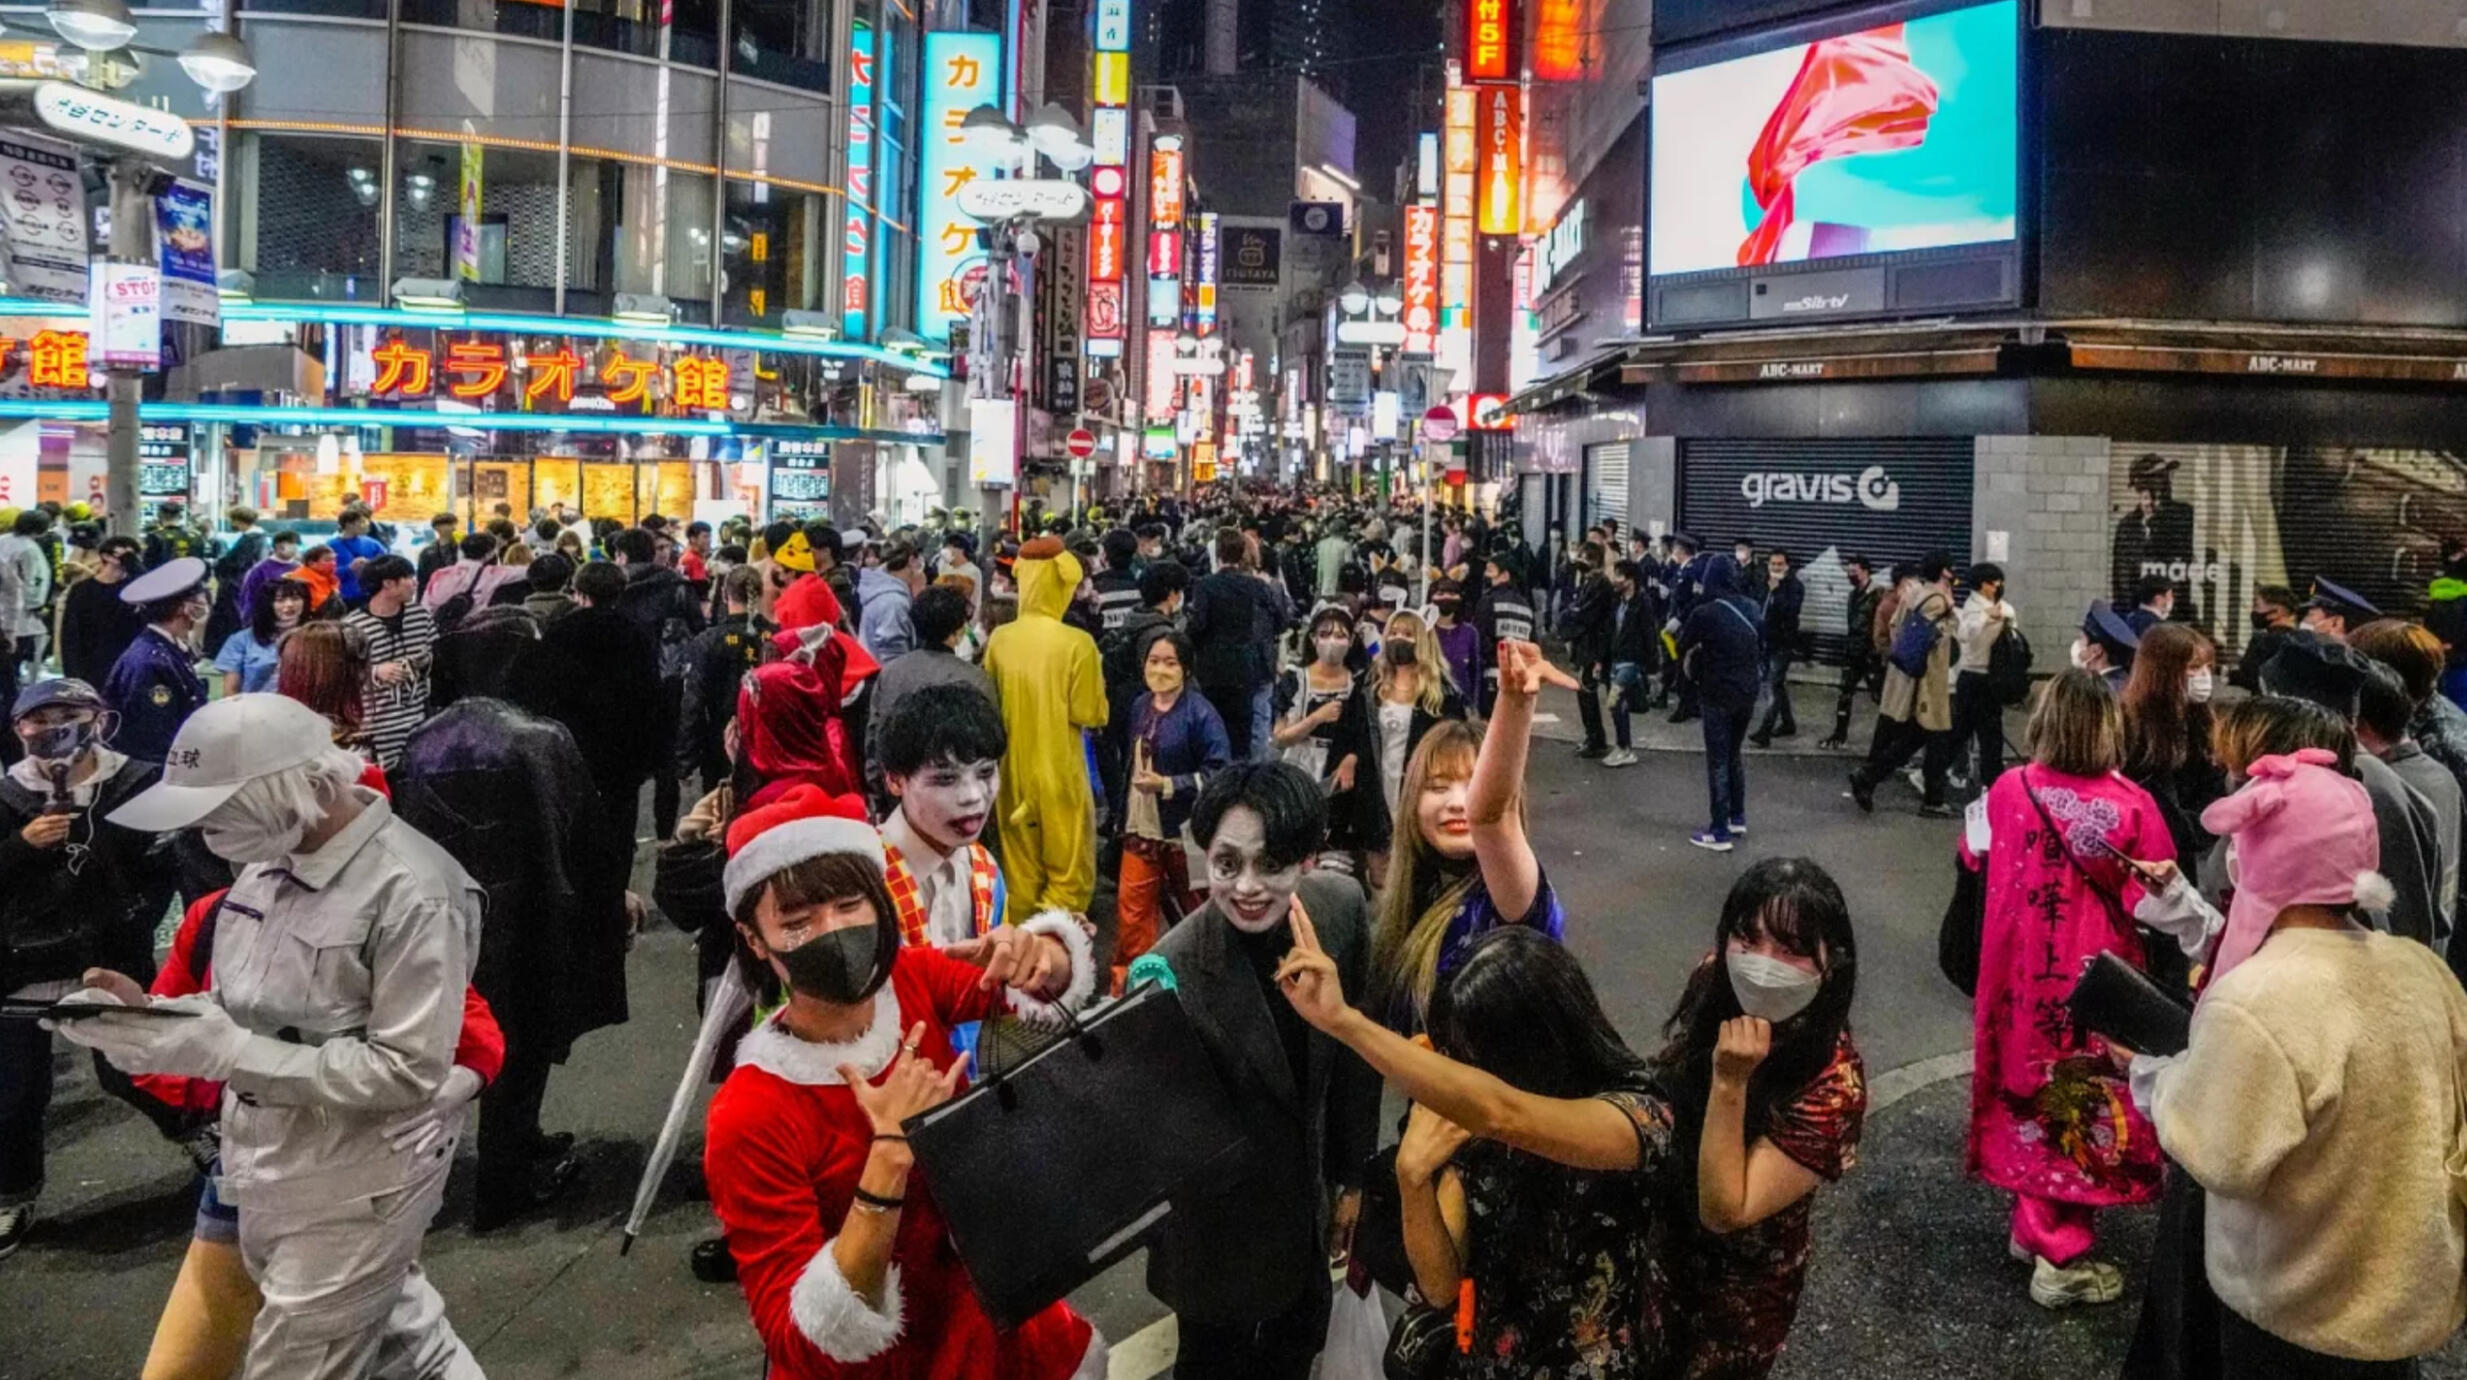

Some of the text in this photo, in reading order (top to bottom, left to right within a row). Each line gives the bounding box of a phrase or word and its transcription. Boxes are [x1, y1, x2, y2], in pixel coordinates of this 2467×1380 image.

[372, 339, 730, 410] カラオケ館
[1760, 363, 1824, 378] ABC-MART
[2248, 356, 2318, 372] ABC-MART
[1741, 472, 1853, 508] gravis
